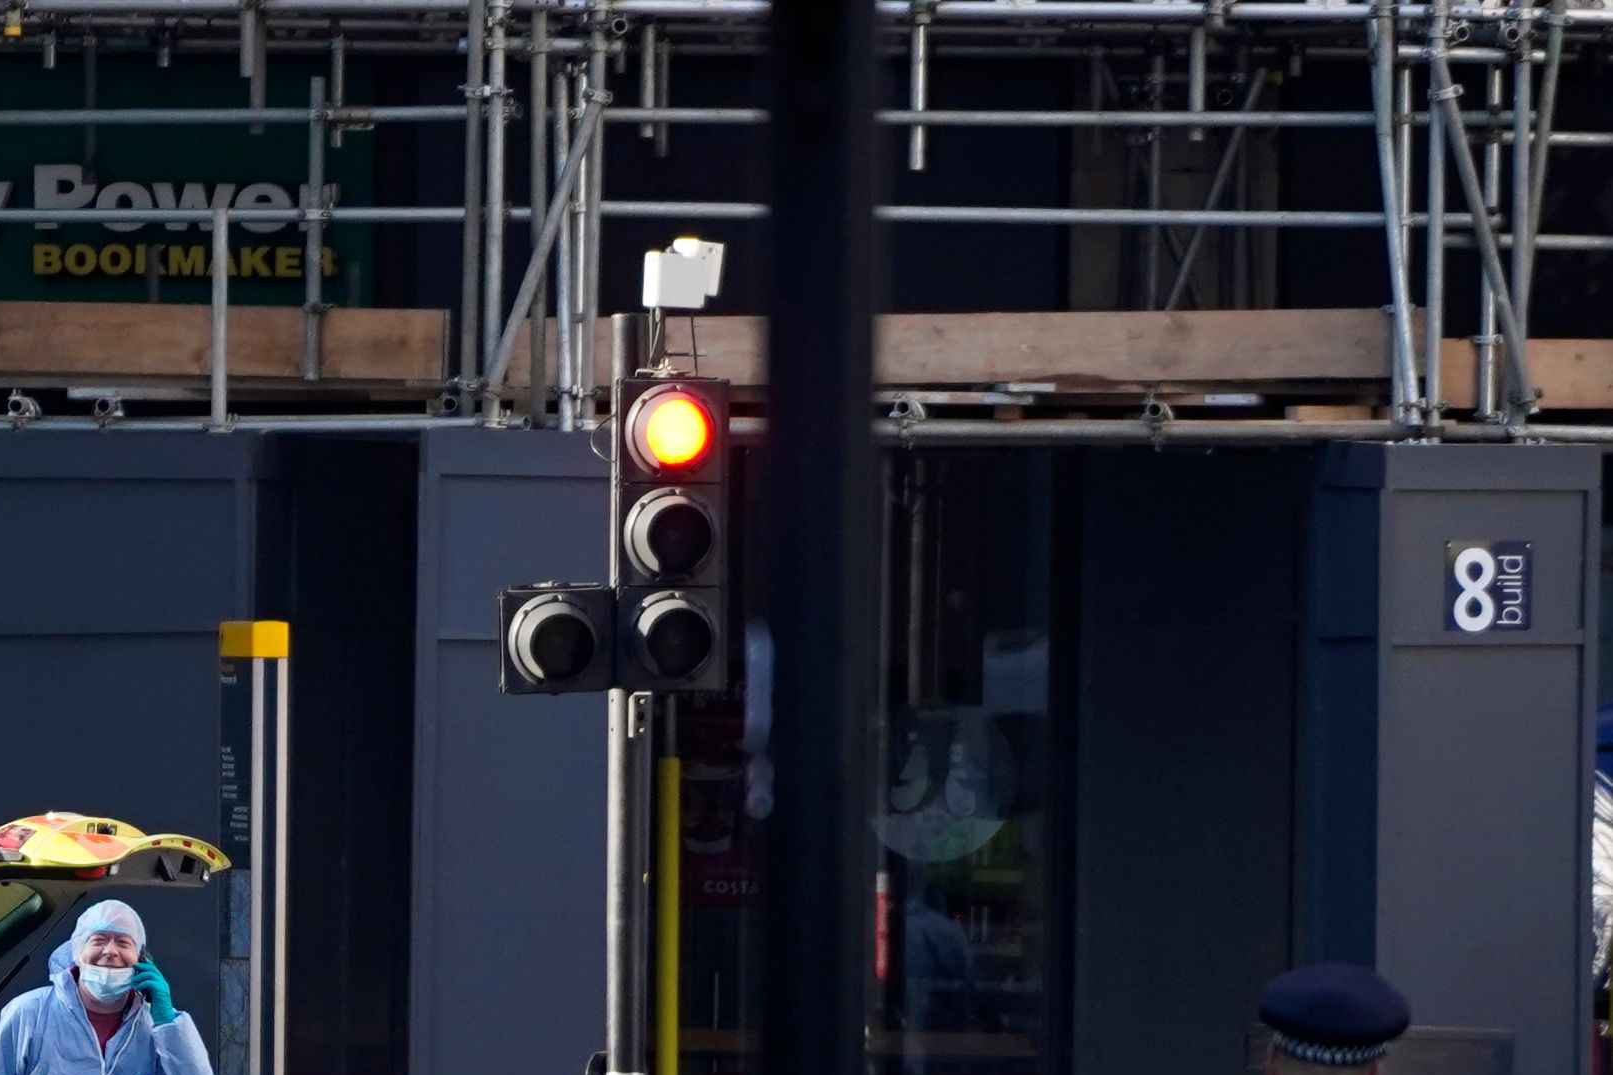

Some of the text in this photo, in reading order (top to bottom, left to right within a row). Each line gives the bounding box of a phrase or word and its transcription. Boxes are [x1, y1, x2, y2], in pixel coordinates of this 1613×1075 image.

[33, 163, 337, 234] Power
[32, 244, 336, 278] BOOKMAKER
[1453, 547, 1495, 632] 8
[1496, 555, 1524, 625] build
[703, 879, 759, 896] COSTA
